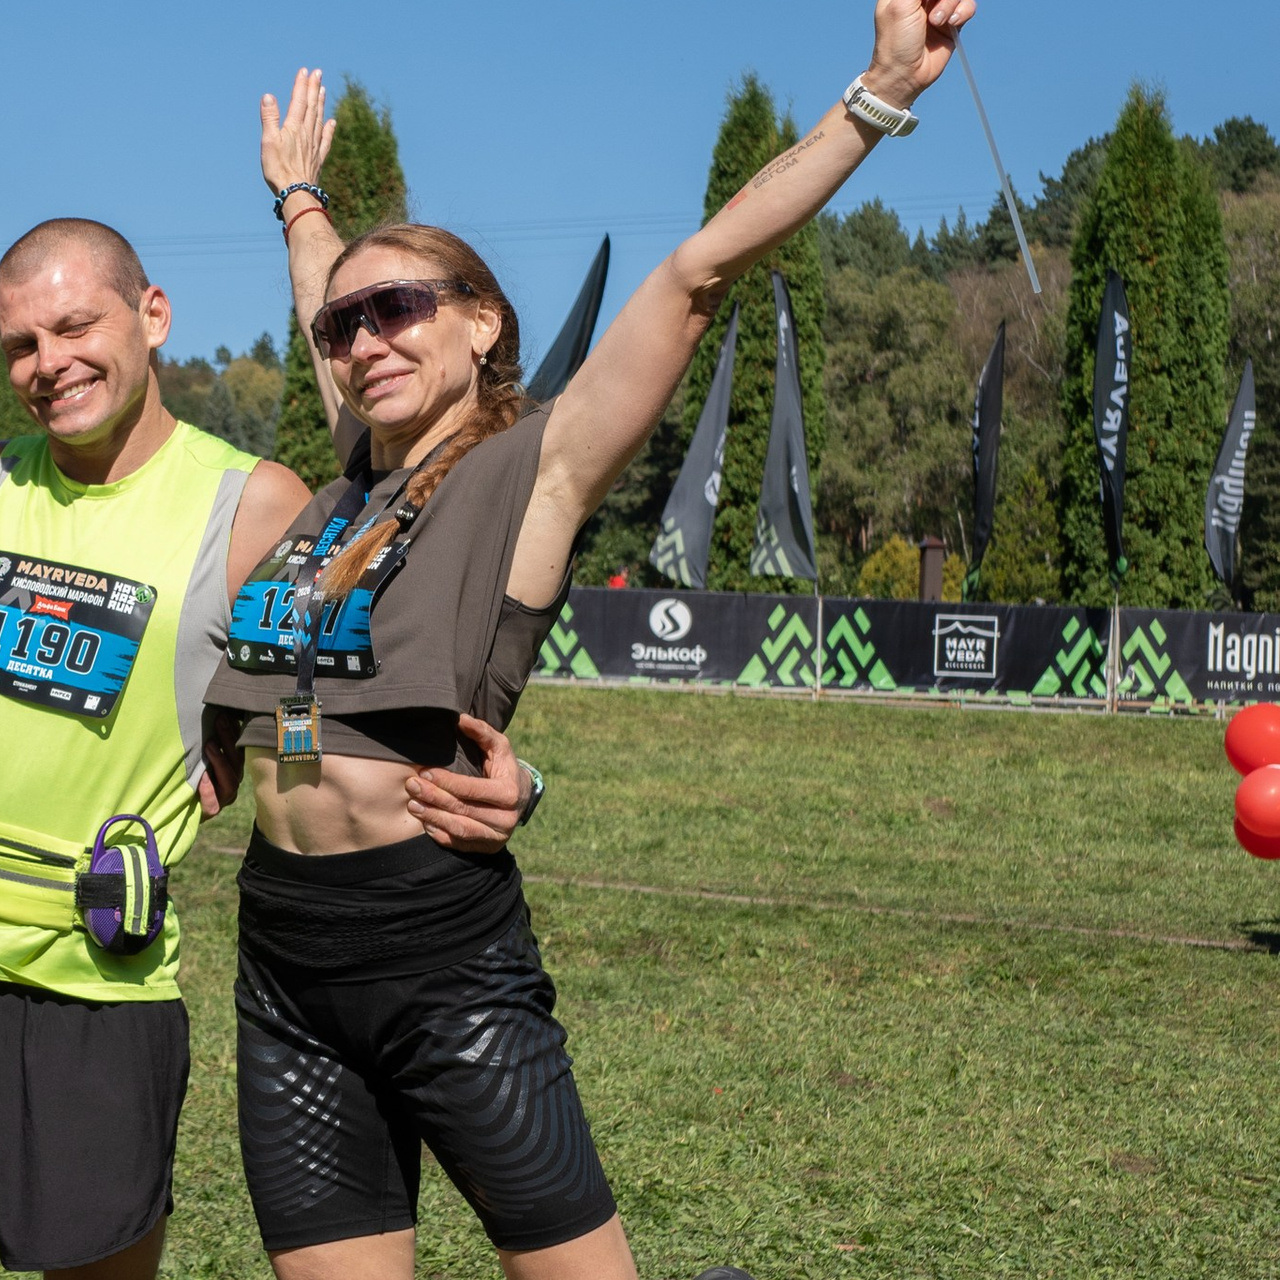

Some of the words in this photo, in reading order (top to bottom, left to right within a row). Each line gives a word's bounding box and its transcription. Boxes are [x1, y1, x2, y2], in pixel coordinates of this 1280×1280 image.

[753, 158, 798, 189] БЕГОМ
[312, 517, 349, 556] ДЕСЯТКА
[16, 560, 108, 592] MAYRVEDA
[10, 576, 68, 598] КИСЛОВОДСКИЙ
[67, 589, 105, 607] МАРАФОН
[107, 600, 134, 614] RUN
[631, 642, 707, 665] Элькоф
[945, 637, 986, 651] MAYR
[945, 649, 986, 663] VEDA
[6, 660, 53, 679] ДЕСЯТКА
[1207, 680, 1253, 691] НАПИТКИ
